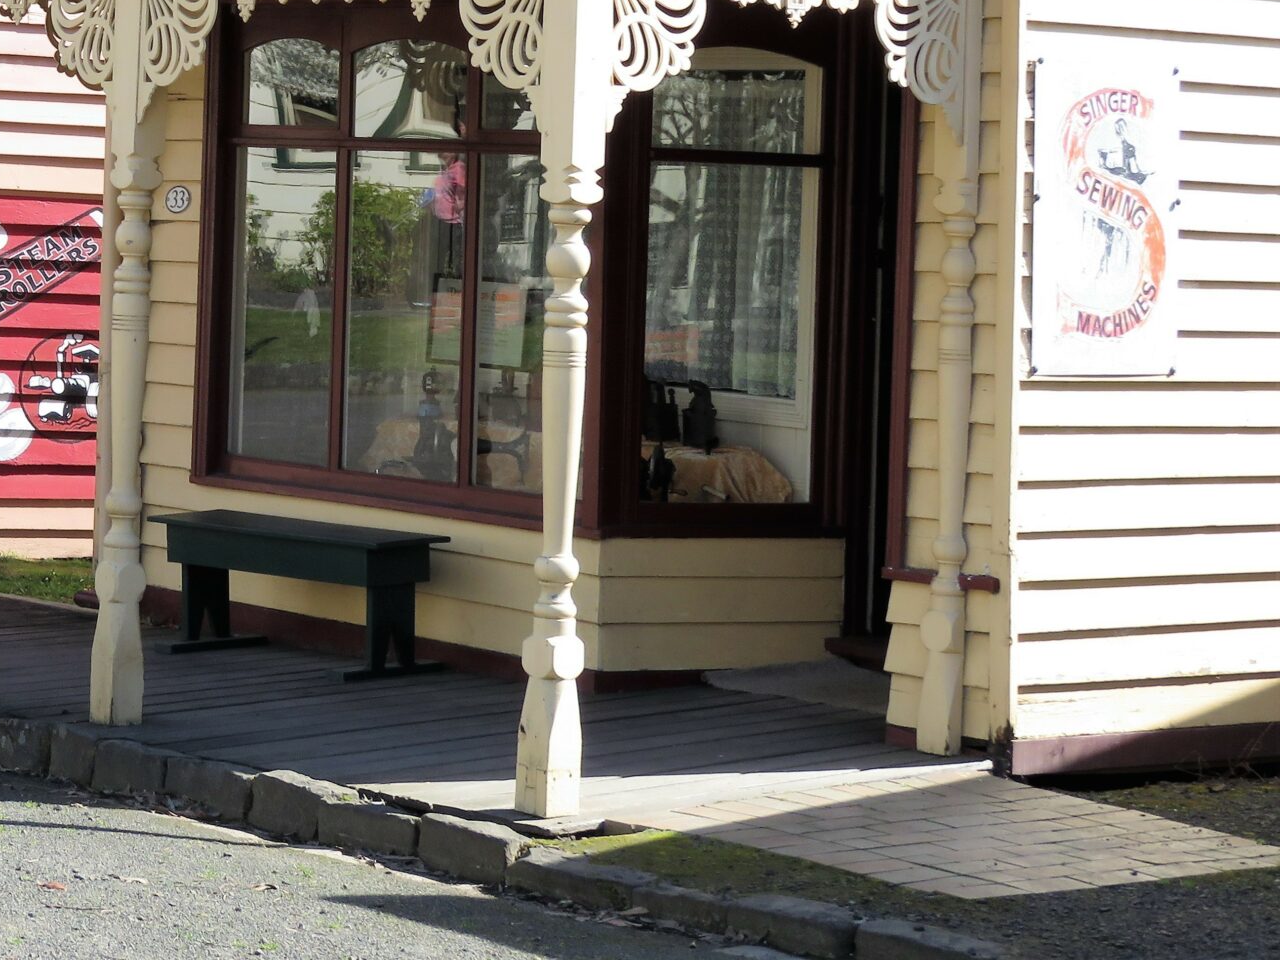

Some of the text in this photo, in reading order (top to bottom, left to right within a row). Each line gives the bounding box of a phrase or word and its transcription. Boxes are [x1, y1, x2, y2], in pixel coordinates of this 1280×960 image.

[1080, 91, 1138, 127] SINGER
[170, 189, 185, 209] 33
[1075, 171, 1148, 230] SEWING
[1076, 280, 1157, 338] MACHINES
